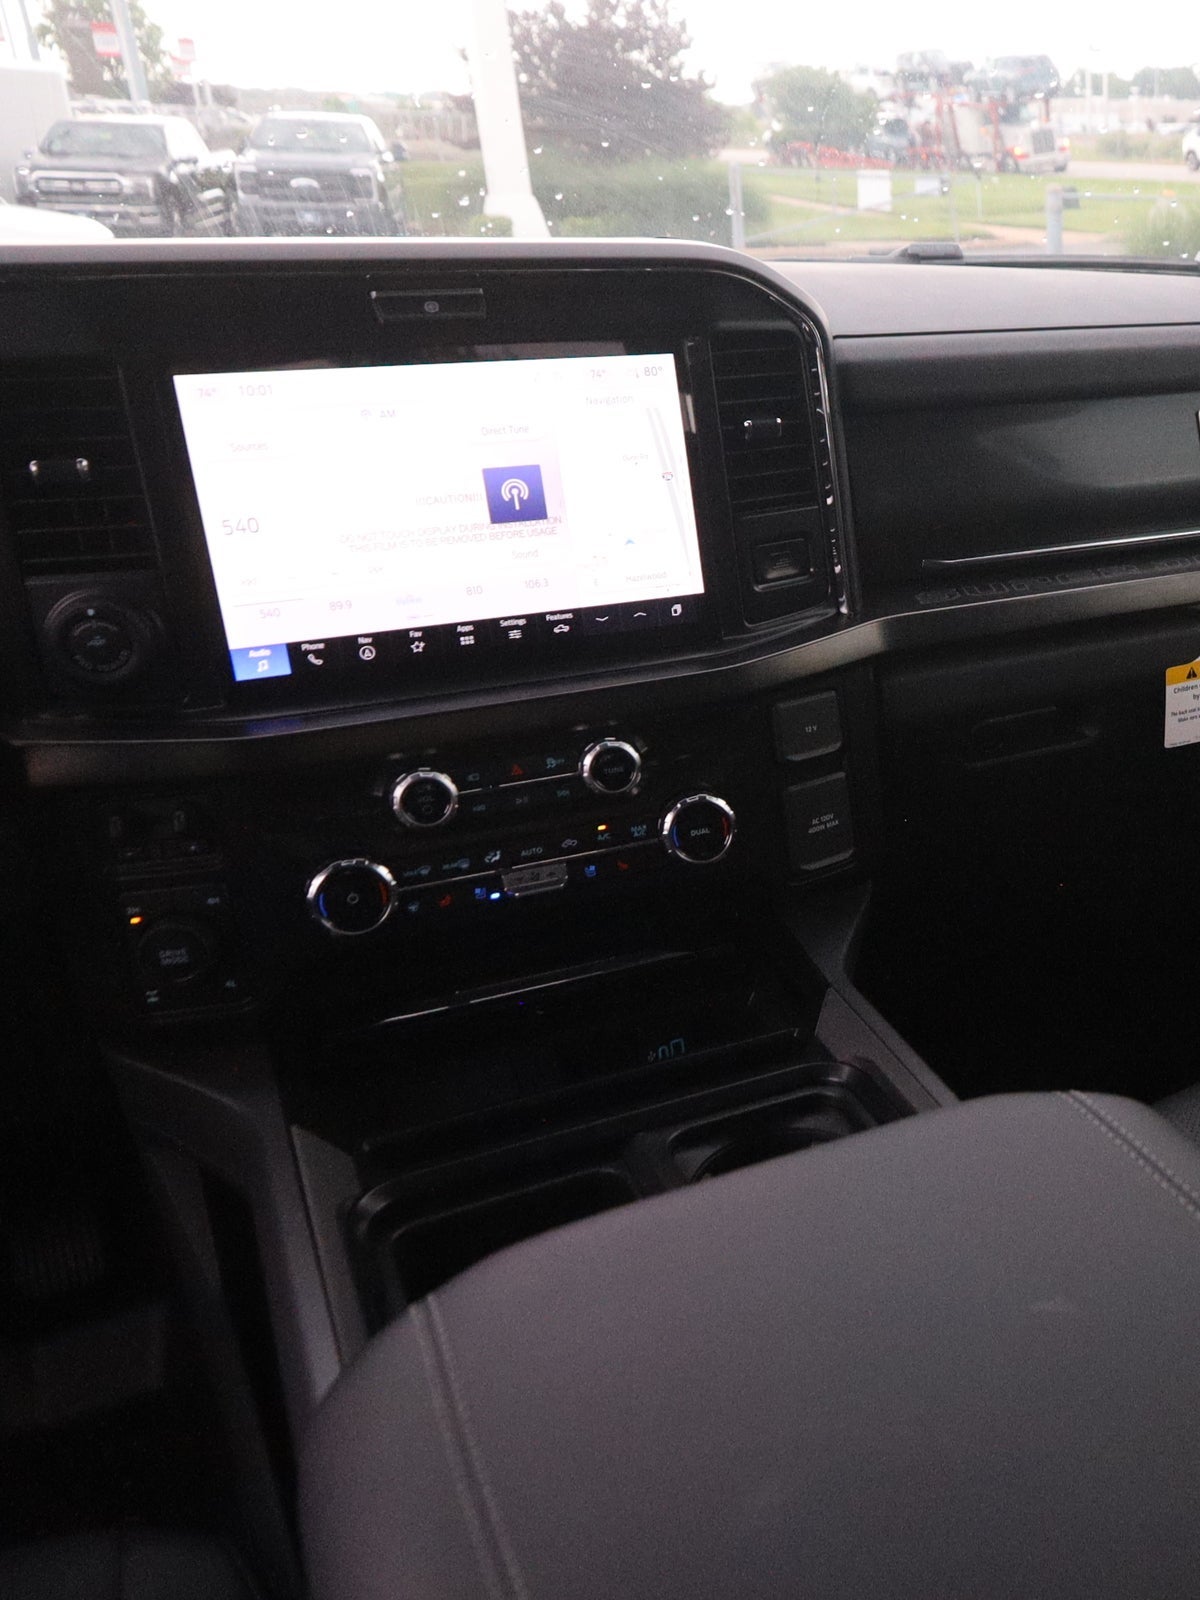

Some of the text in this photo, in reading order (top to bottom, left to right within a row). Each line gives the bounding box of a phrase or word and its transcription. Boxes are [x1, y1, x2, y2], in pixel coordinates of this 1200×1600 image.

[222, 516, 260, 536] 540
[489, 530, 526, 541] BEFORE
[528, 526, 558, 538] USAGE
[328, 600, 352, 612] 89.9
[466, 585, 483, 596] 810
[546, 612, 574, 622] Features
[500, 618, 527, 628] Settings
[456, 624, 474, 634] Apps
[409, 630, 423, 639] Fav
[358, 636, 372, 645] Nav
[301, 642, 325, 651] Phone
[1173, 684, 1198, 694] Children
[1192, 692, 1200, 701] by
[690, 828, 710, 837] DUAL
[521, 846, 544, 857] AUTO
